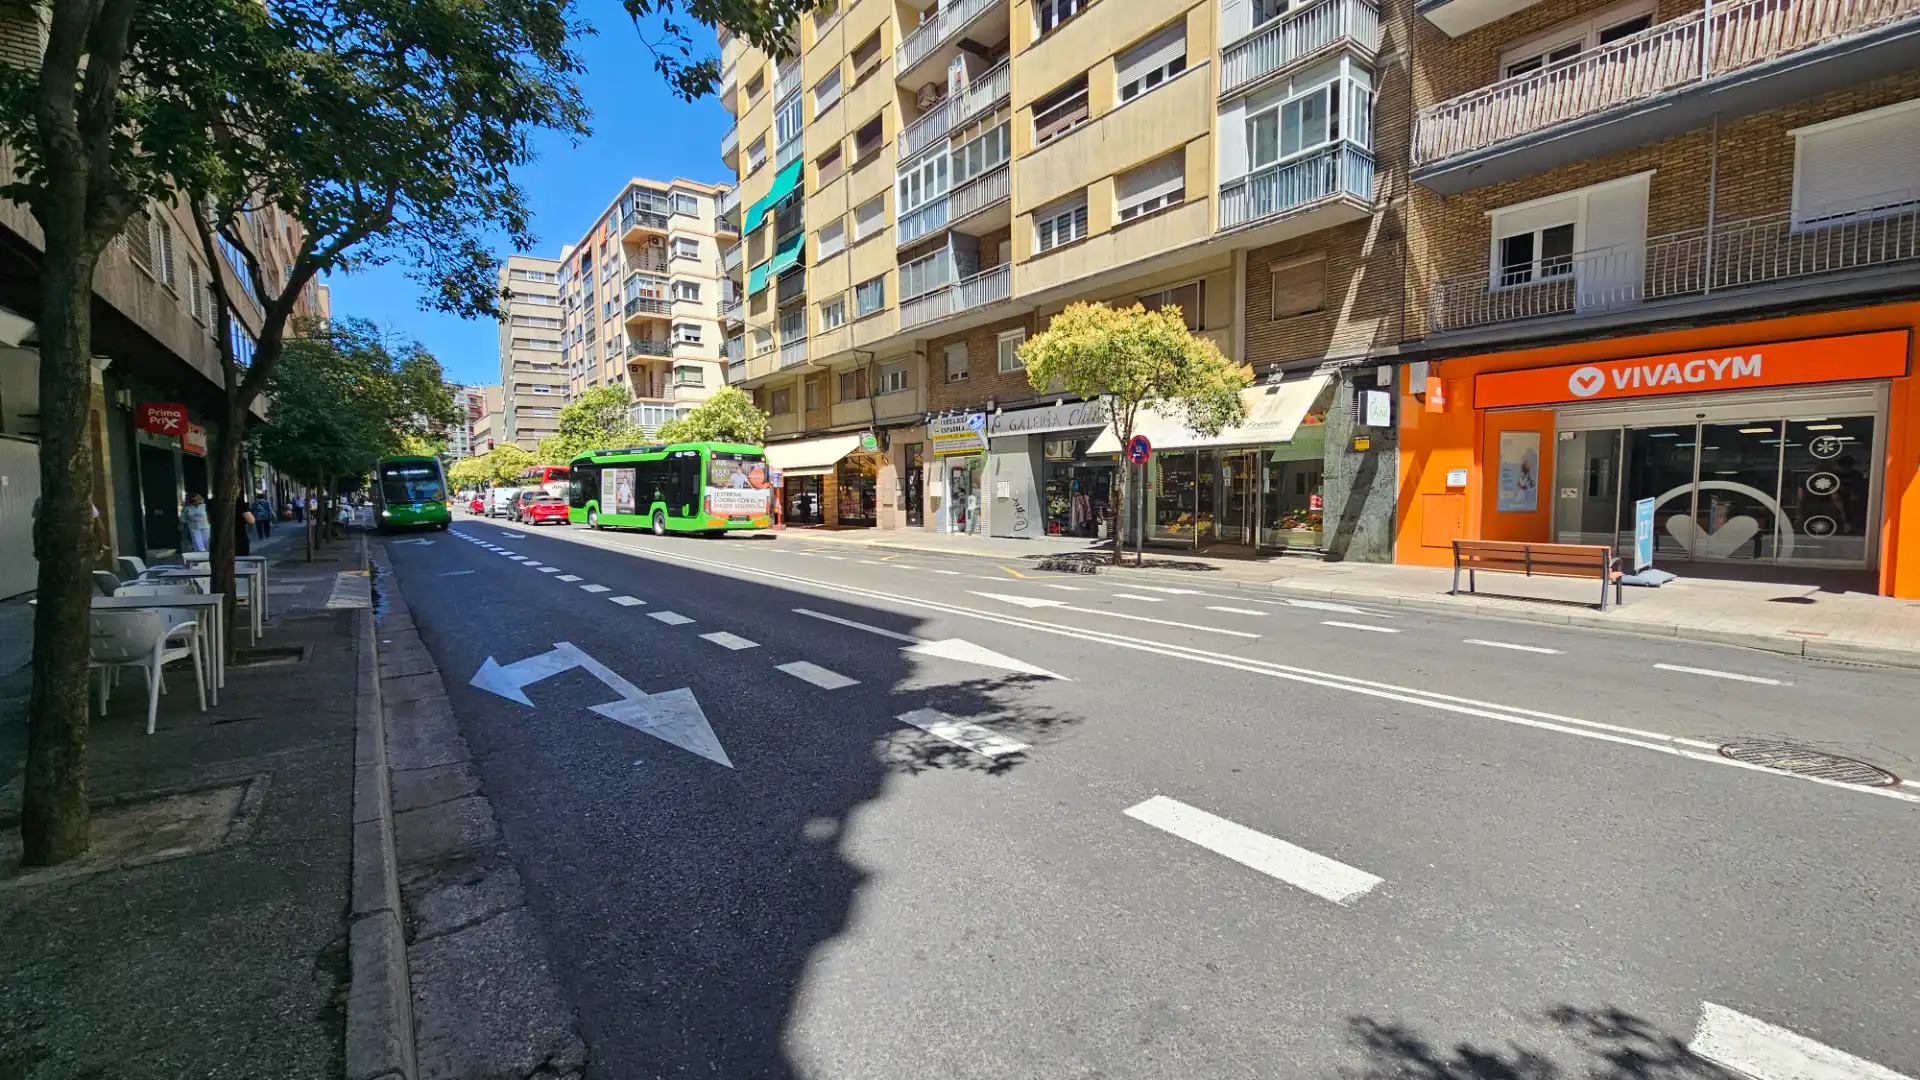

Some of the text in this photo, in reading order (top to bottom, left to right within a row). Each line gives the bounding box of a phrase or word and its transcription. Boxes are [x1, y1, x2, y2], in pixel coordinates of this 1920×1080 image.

[1611, 354, 1762, 390] VIVAGYM
[148, 408, 181, 417] Prima
[1009, 411, 1061, 432] GALERÍA
